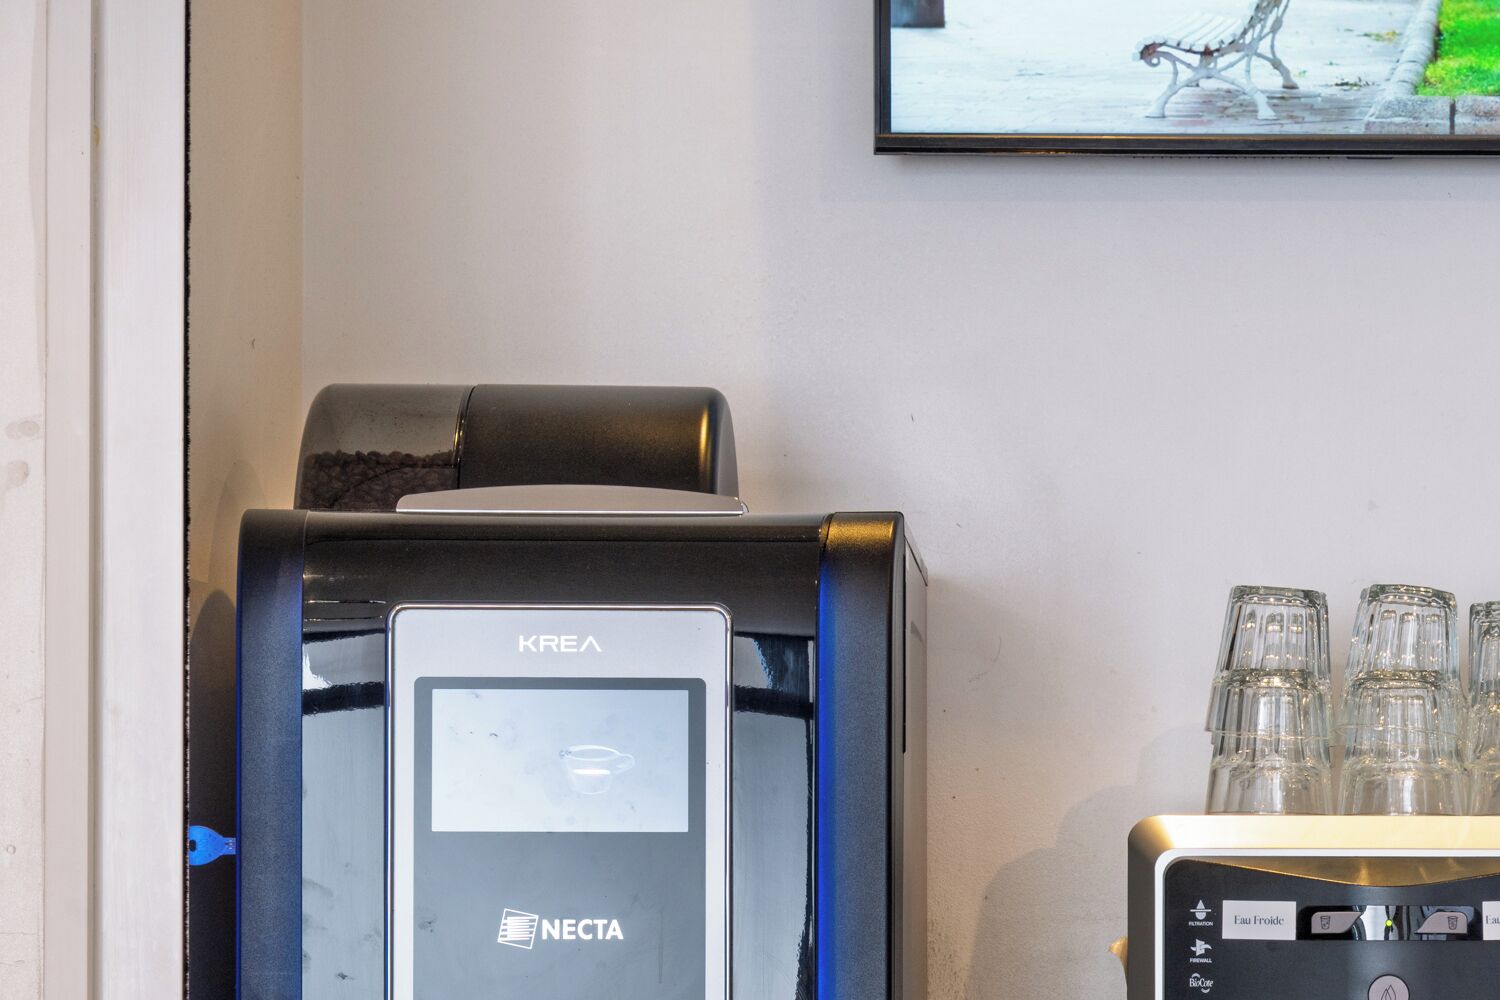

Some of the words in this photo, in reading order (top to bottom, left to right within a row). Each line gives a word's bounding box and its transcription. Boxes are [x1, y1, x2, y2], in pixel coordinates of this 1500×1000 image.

[518, 635, 603, 652] KREA
[1234, 915, 1251, 925] Eau
[1254, 915, 1285, 926] Froide
[541, 918, 624, 941] NECTA
